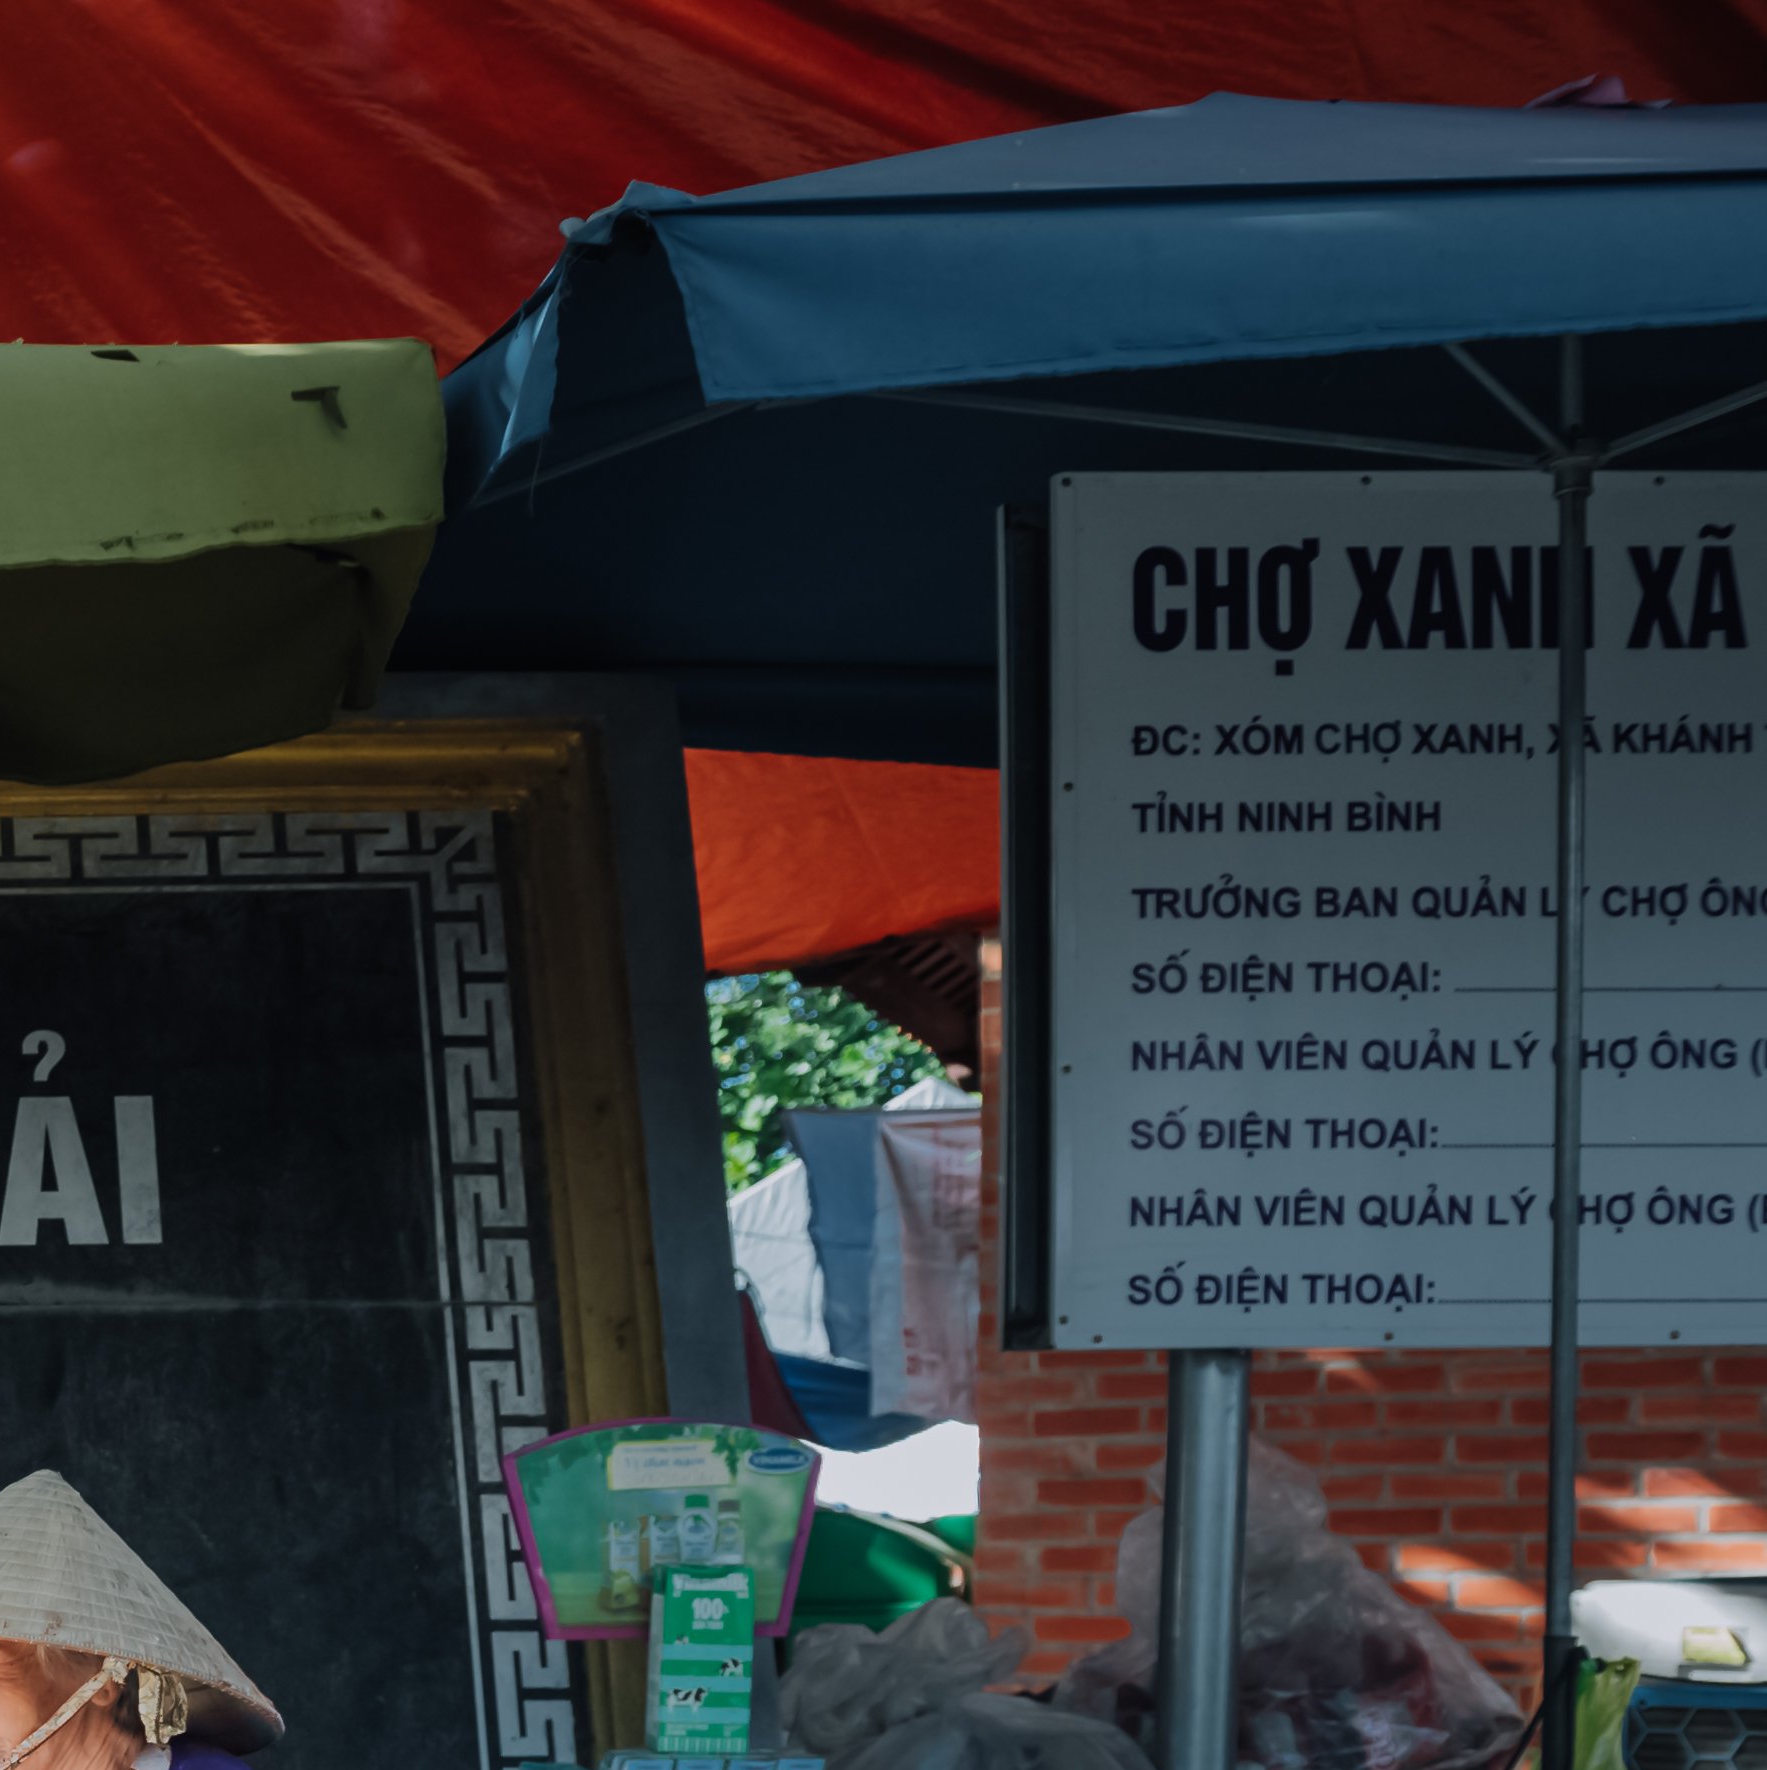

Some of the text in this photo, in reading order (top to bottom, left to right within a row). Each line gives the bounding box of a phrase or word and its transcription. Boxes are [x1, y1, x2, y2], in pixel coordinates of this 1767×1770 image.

[1133, 538, 1319, 676] CHỢ
[1627, 522, 1747, 649] XÃ
[1131, 725, 1202, 756] ĐC:
[1214, 716, 1304, 756] XÓM
[1315, 720, 1403, 763] CHỢ
[1411, 723, 1536, 760] XANH,
[1612, 715, 1753, 754] KHÁNH
[1131, 790, 1442, 833] TỈNH NINH BÌNH
[1131, 873, 1767, 926] TRƯỞNG BAN QUẢN L CHỢ ÔN
[1131, 949, 1441, 1002] SỐ ĐIỆN THOẠI:
[1131, 1033, 1244, 1071] NHÂN
[1256, 1032, 1347, 1070] VIÊN
[1361, 1027, 1476, 1072] QUẢN
[1490, 1031, 1539, 1070] LÝ
[1552, 1035, 1638, 1078] HỢ
[1650, 1030, 1738, 1070] ÔNG
[1130, 1105, 1439, 1158] SỐ ĐIỆN THOẠI:
[1130, 1188, 1242, 1227] NHÂN
[1254, 1187, 1345, 1226] VIÊN
[1358, 1183, 1473, 1228] QUẢN
[1487, 1186, 1536, 1226] LÝ
[1549, 1192, 1635, 1234] HỢ
[1647, 1186, 1735, 1226] ÔNG
[1128, 1260, 1436, 1313] SỐ ĐIỆN THOẠI:
